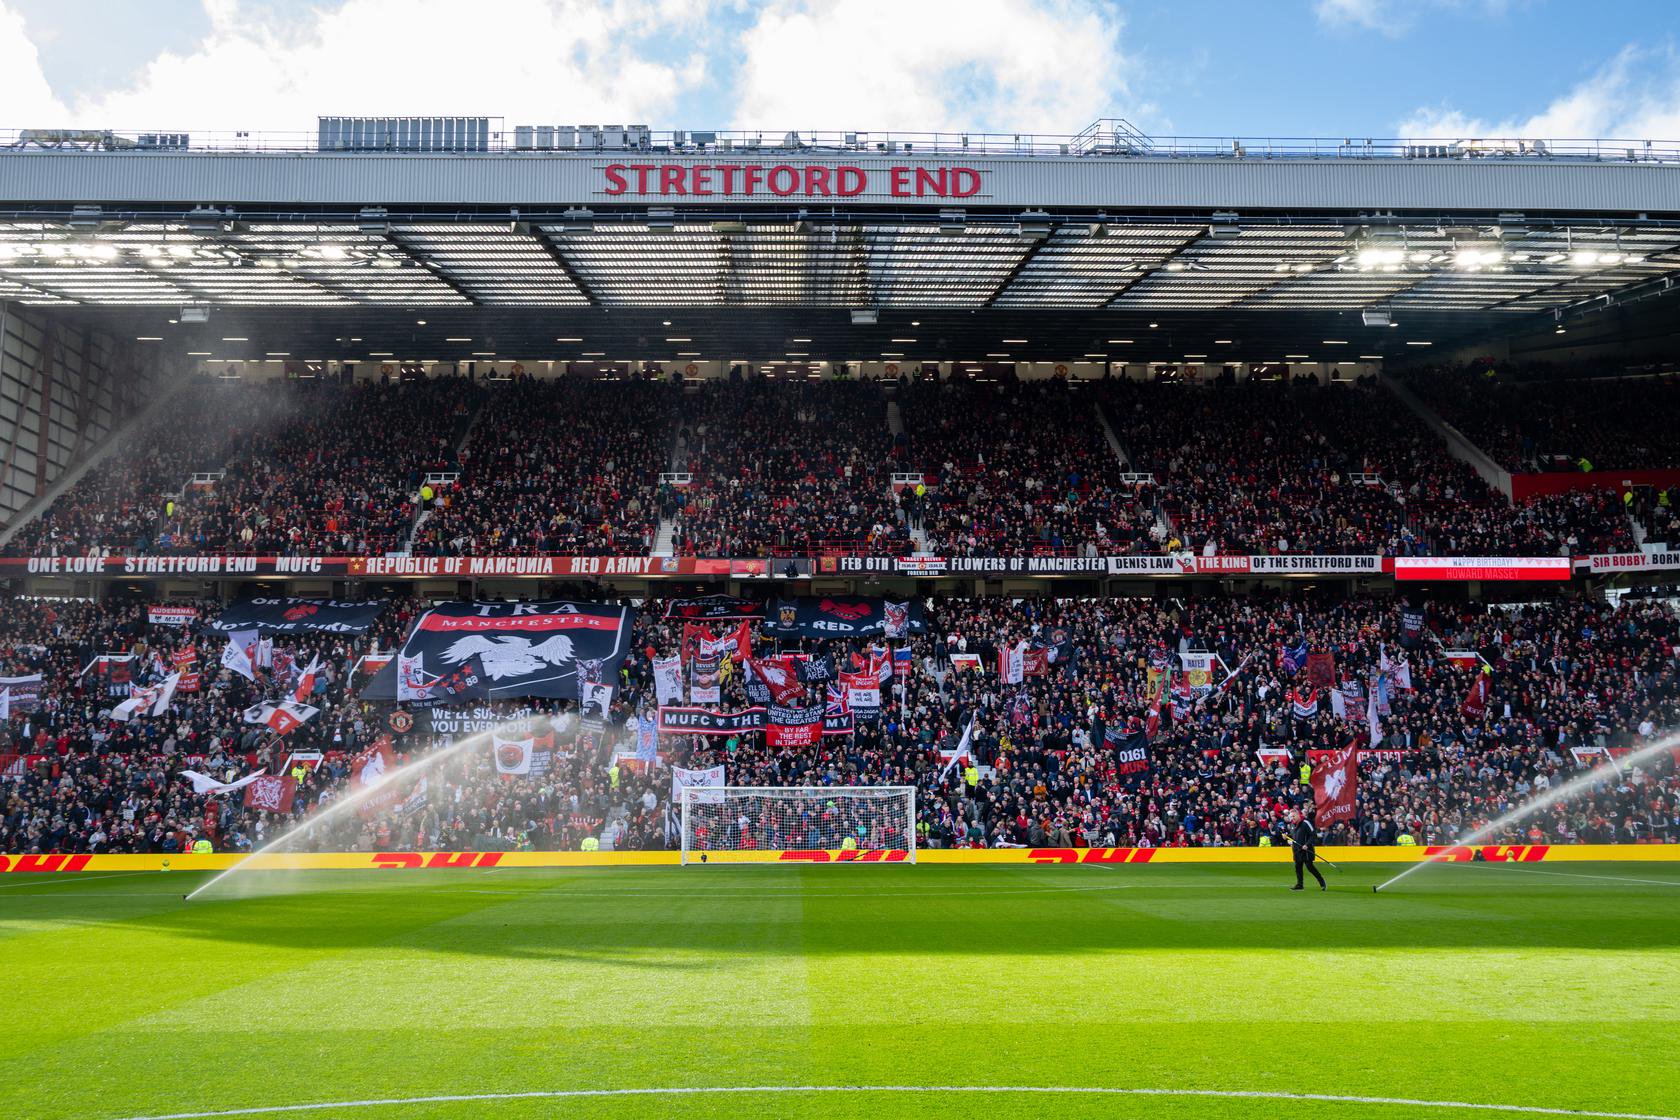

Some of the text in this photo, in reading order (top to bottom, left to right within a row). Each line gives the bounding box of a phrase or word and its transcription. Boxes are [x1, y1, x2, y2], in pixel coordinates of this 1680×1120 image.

[605, 164, 981, 197] STRETFORD END
[27, 557, 322, 572] ONE LOVE STRETFORD END MUFC
[445, 557, 464, 573] OF
[841, 558, 862, 571] FEB
[866, 558, 888, 571] 6TH
[951, 557, 1106, 571] FLOWERS OF MANCHESTER
[1115, 557, 1375, 569] DENIS LAW THE KING OF THE STRETFORD END
[1593, 557, 1610, 568] SIR
[1652, 553, 1680, 565] BORN
[1446, 568, 1519, 579] HOWARD MASSEY
[473, 603, 580, 616] TRA
[441, 617, 600, 627] MANCHESTER
[812, 620, 854, 631] RED
[664, 714, 760, 726] MUFC THE
[768, 709, 792, 718] UNITED
[771, 715, 820, 725] THE GREATEST
[431, 721, 459, 733] YOU
[1120, 748, 1146, 763] 0161
[1119, 760, 1149, 774] MUFC
[0, 855, 93, 872] HL
